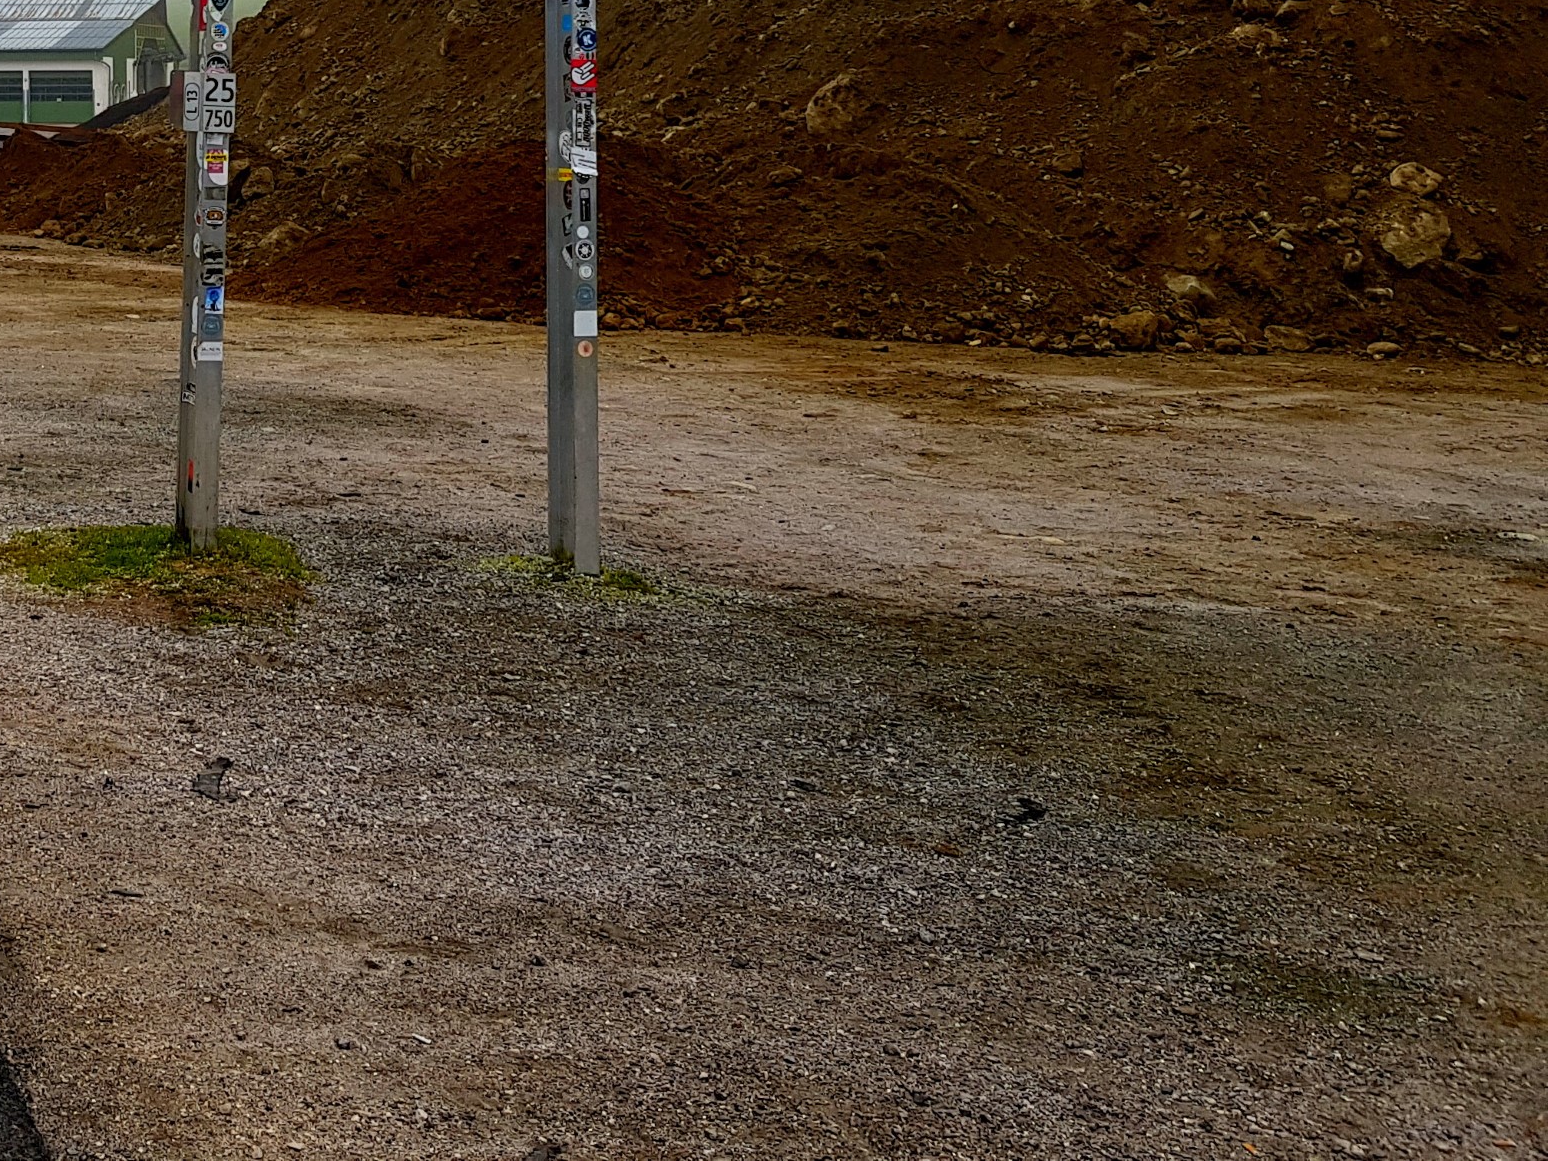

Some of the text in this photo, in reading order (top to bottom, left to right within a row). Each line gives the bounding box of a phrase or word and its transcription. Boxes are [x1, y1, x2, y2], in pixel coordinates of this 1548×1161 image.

[186, 89, 198, 102] 13
[204, 77, 235, 103] 25
[204, 109, 233, 128] 750
